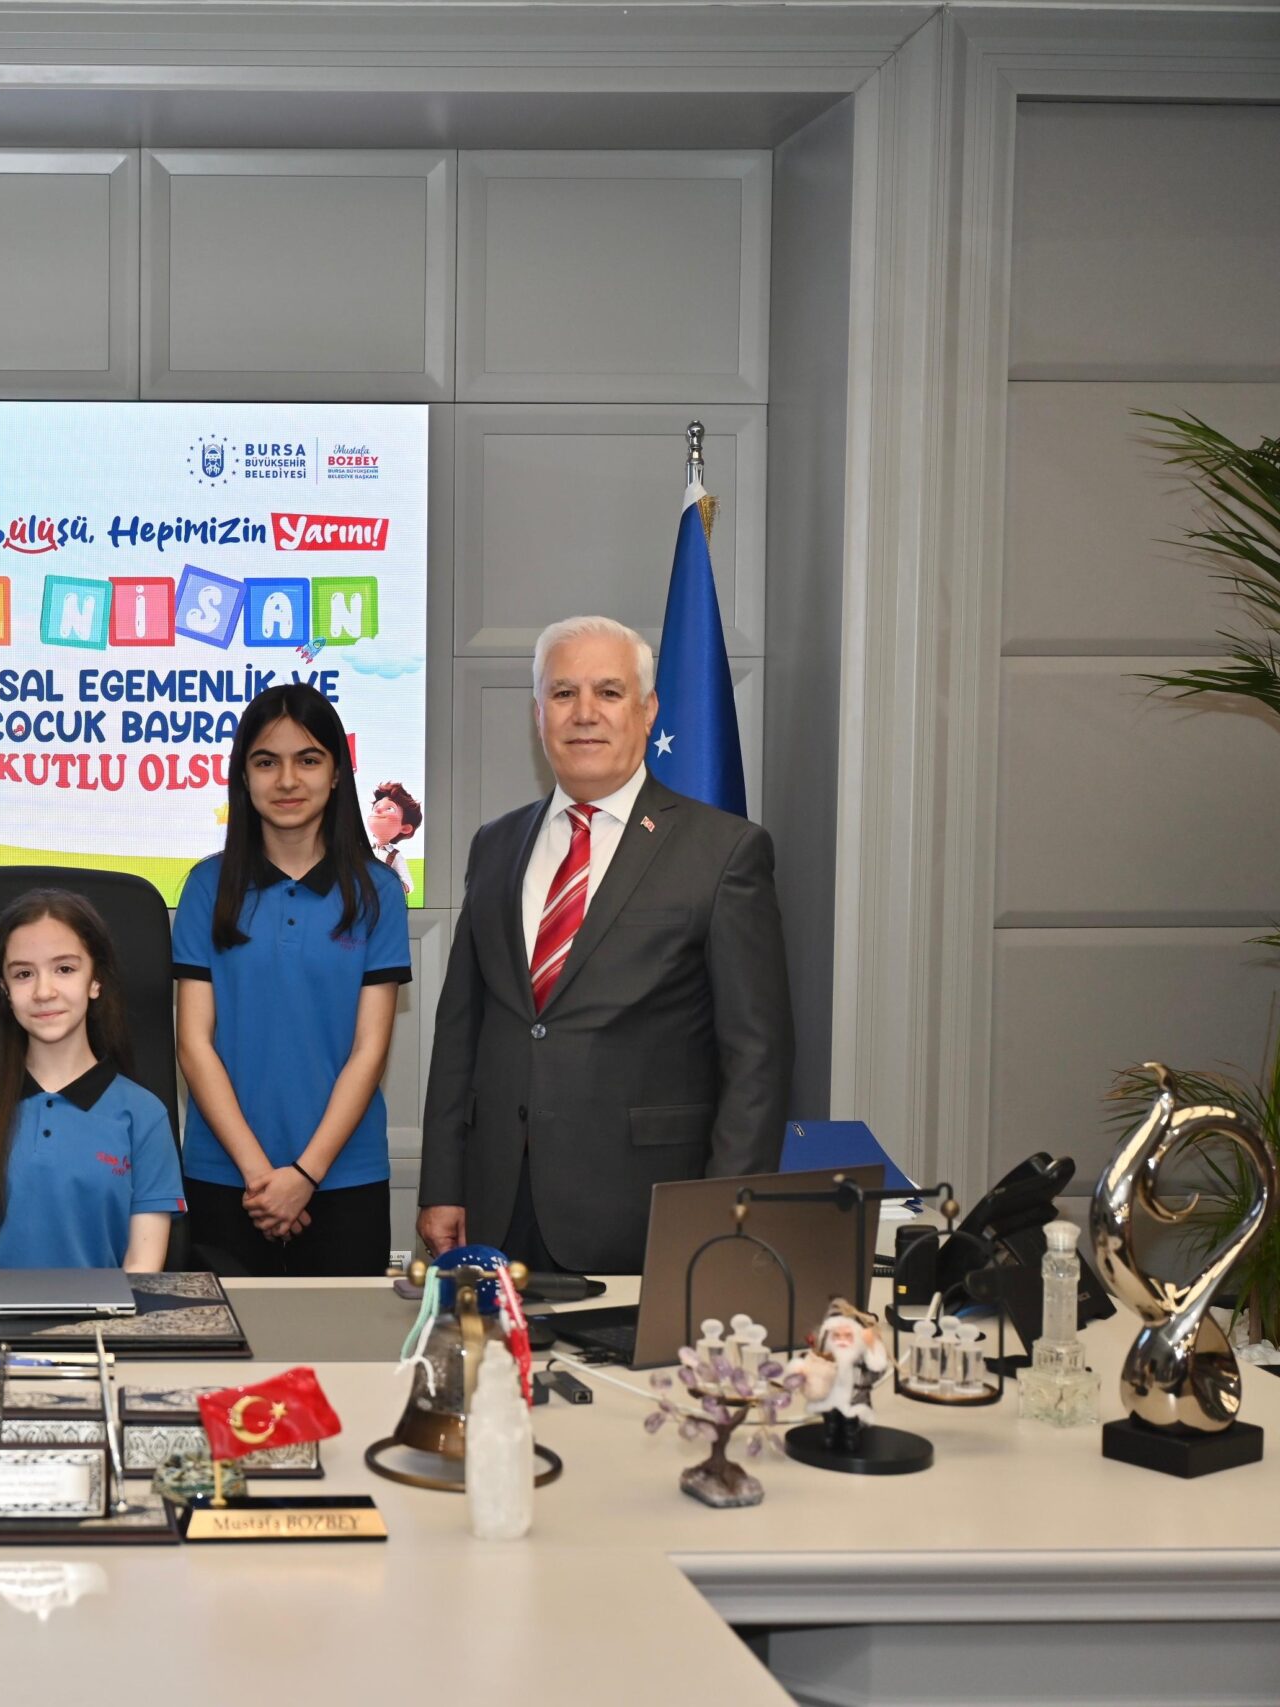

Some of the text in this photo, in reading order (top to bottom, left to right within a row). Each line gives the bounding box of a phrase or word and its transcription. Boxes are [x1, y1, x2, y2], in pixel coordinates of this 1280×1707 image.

[245, 444, 306, 456] BURSA
[333, 444, 370, 457] Mustafa
[327, 456, 378, 466] BOZBEY
[245, 468, 306, 478] BELEDİYESİ
[79, 663, 276, 703] EGEMENLİK
[122, 710, 239, 743] BAYRA
[212, 1515, 280, 1531] Mustafa
